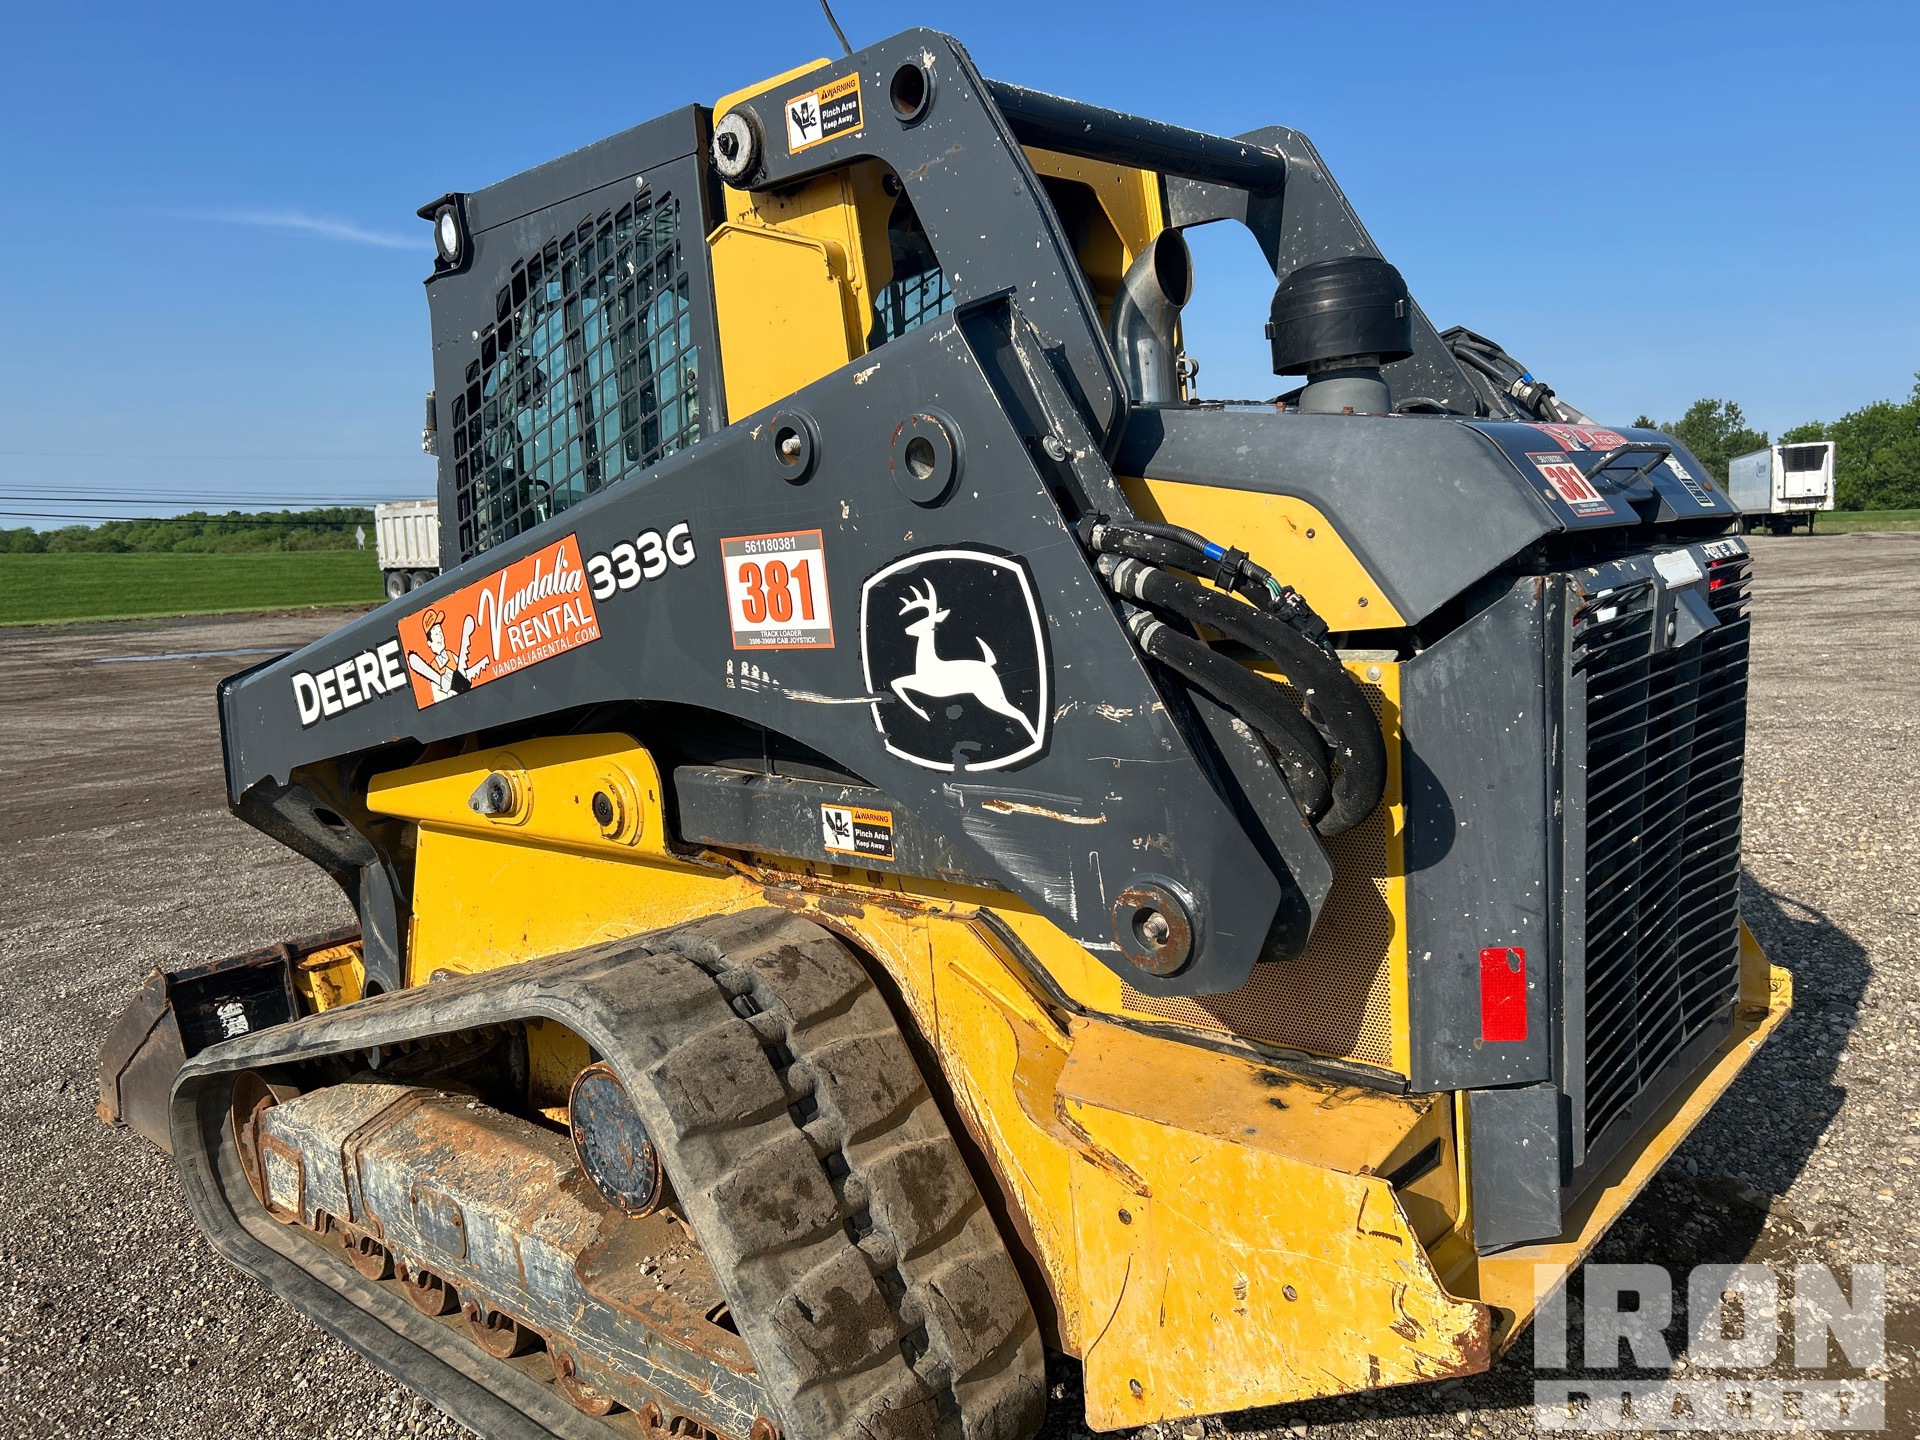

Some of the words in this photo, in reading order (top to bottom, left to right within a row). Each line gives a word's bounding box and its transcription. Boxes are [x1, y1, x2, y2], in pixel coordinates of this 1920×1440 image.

[826, 80, 856, 97] WARNING
[822, 106, 841, 120] Pinch
[841, 100, 857, 113] Area
[823, 120, 838, 131] Keep
[1544, 466, 1597, 500] 381
[744, 536, 796, 553] 561180381
[586, 522, 697, 601] 333G
[738, 559, 815, 624] 381
[478, 545, 583, 661] Vandalia
[507, 597, 593, 653] RENTAL
[779, 629, 803, 637] LOADER
[790, 636, 817, 644] JOYSTICK
[491, 625, 598, 677] VANDALIARENTAL.COM
[291, 639, 408, 726] DEERE
[861, 813, 889, 823] WARNING
[855, 828, 873, 839] Pinch
[874, 831, 889, 841] Area
[856, 839, 870, 849] Keep
